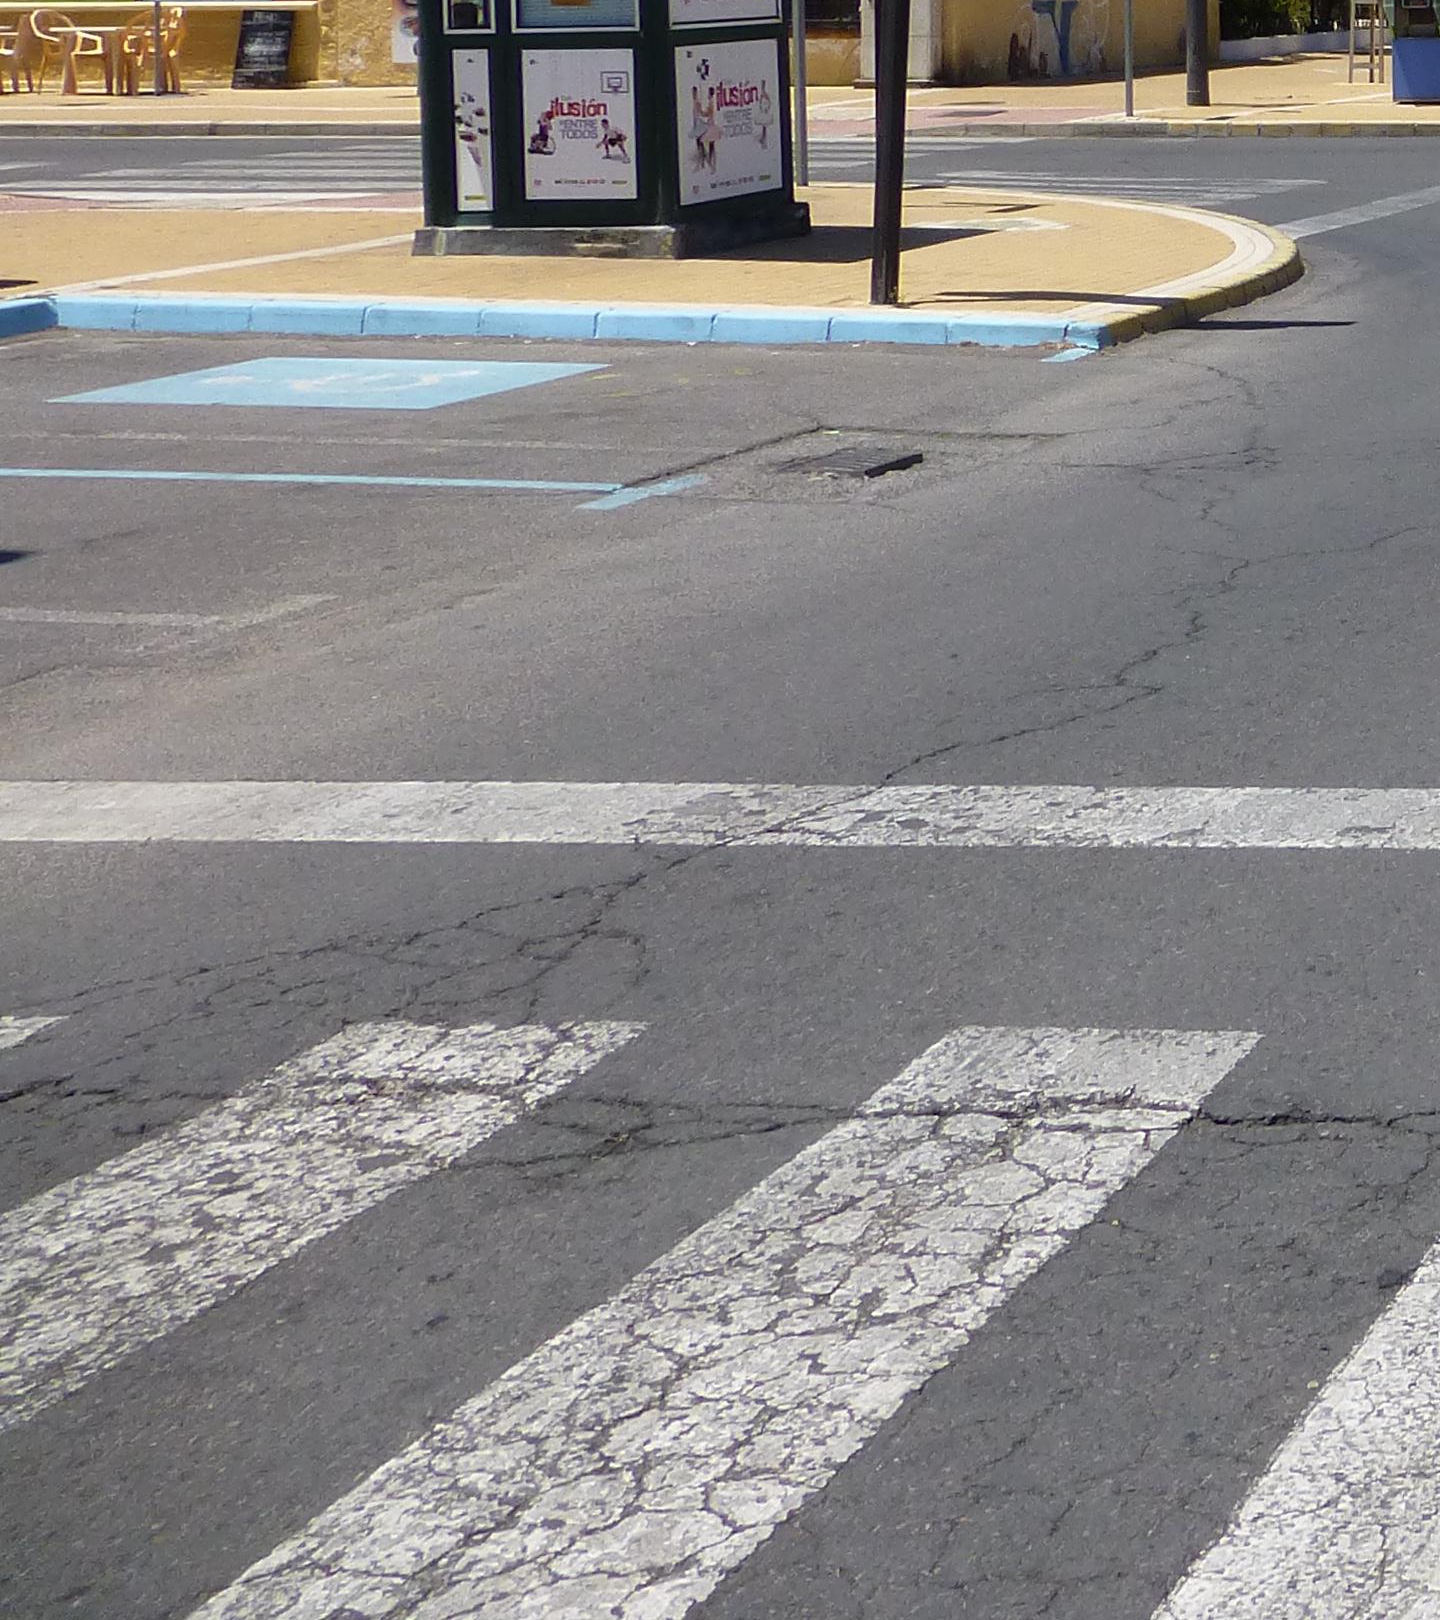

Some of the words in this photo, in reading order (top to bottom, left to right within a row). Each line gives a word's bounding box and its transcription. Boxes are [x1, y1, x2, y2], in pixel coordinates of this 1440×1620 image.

[549, 96, 608, 118] ilusión
[716, 81, 758, 111] ilusión
[560, 129, 598, 139] TODOS
